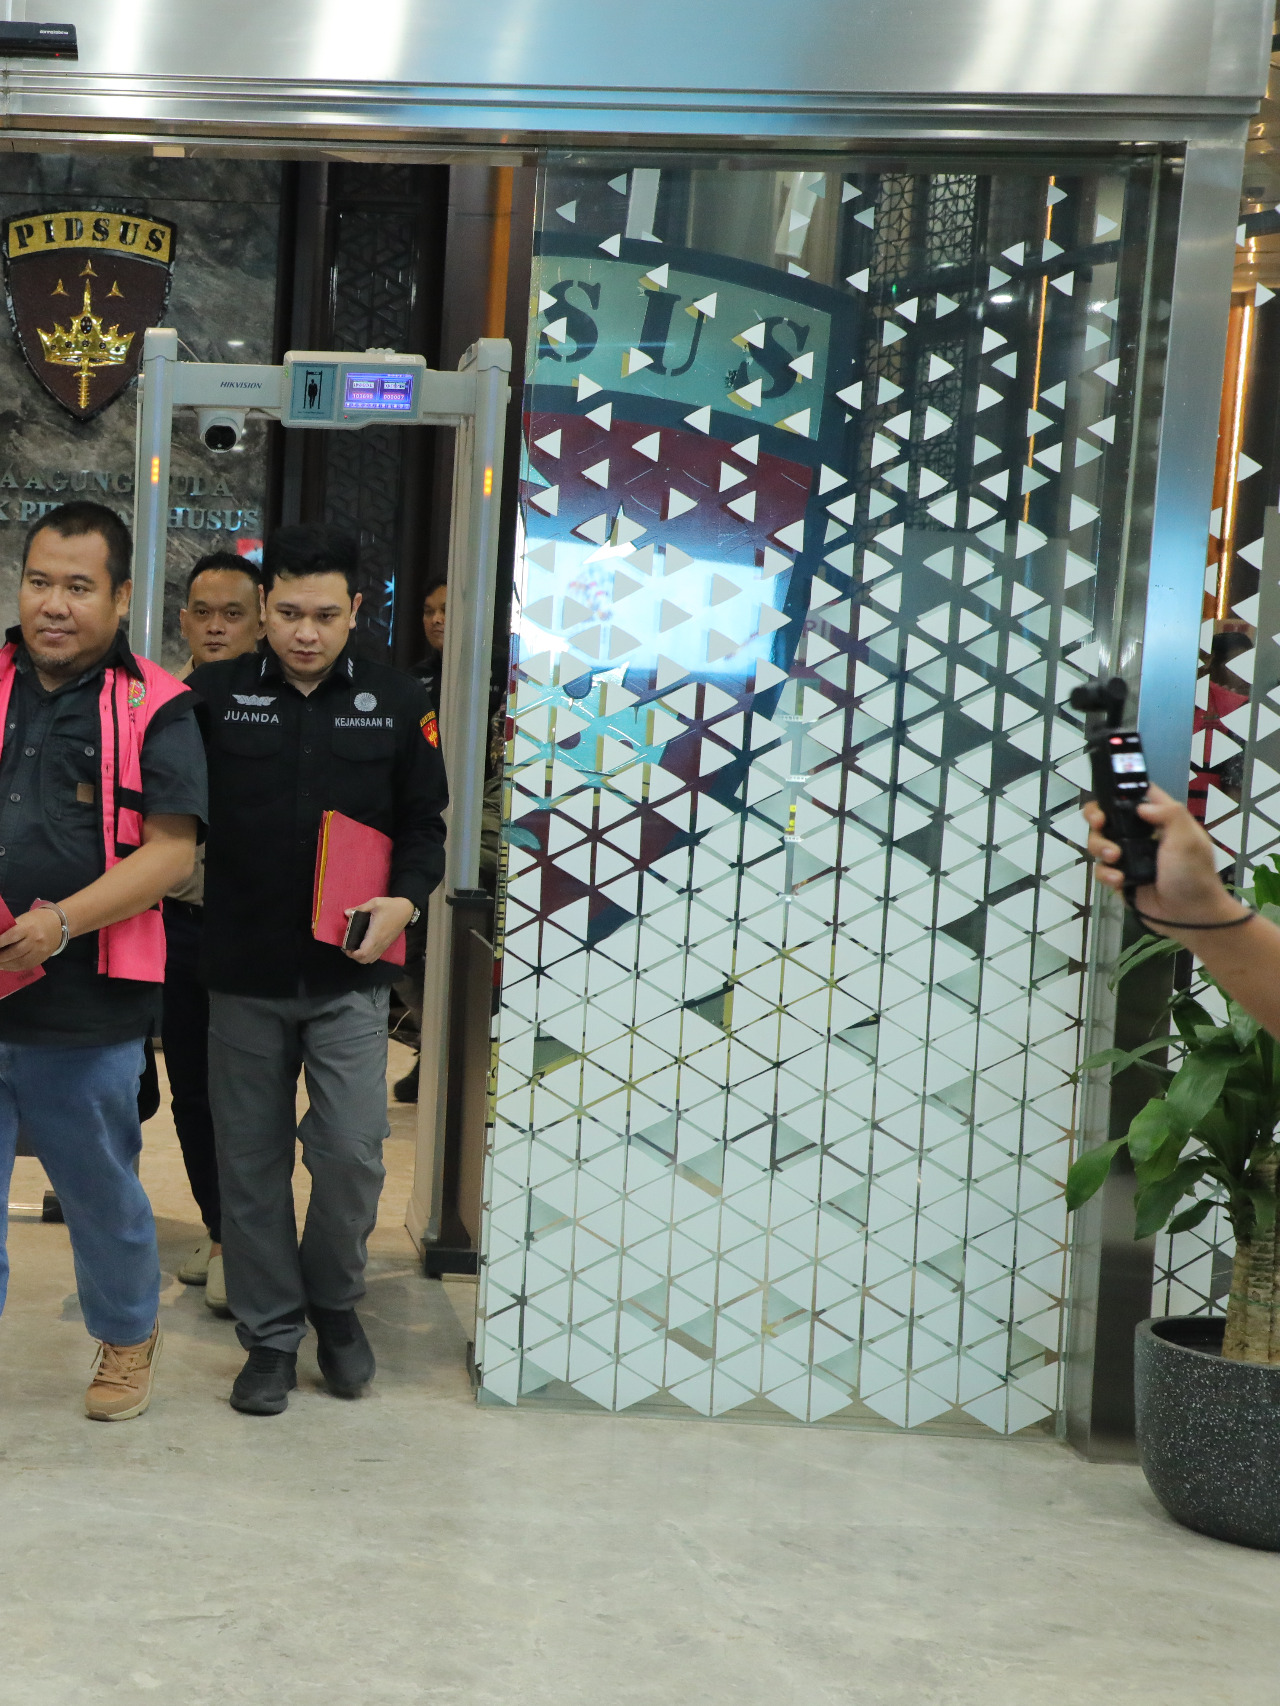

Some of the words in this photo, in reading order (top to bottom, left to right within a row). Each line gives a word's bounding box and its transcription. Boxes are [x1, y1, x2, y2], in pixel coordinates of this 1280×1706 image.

[14, 217, 166, 253] PIDSUS
[220, 380, 263, 389] HIKVISION
[23, 468, 135, 493] AGUNG
[168, 475, 234, 497] UDA
[167, 506, 259, 532] HUSUS
[224, 710, 279, 723] JUANDA
[334, 717, 383, 728] KEJAKSAAN
[385, 718, 393, 728] RI
